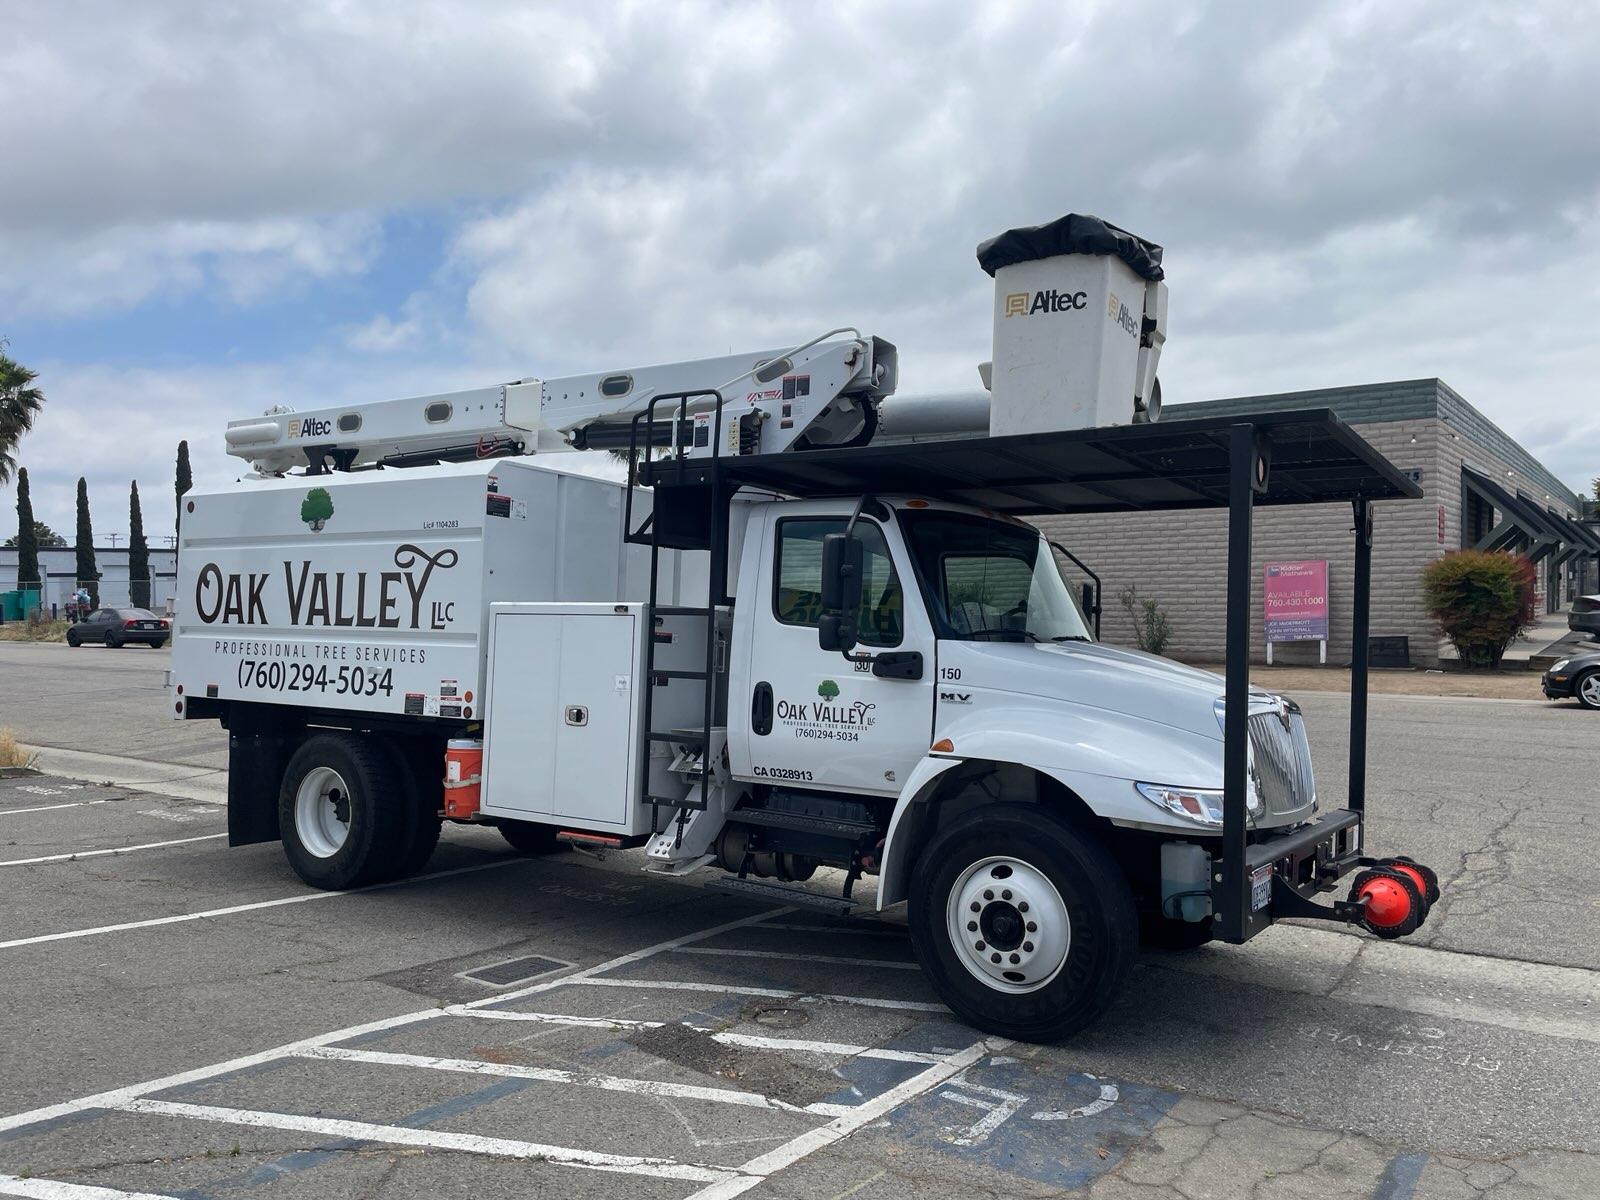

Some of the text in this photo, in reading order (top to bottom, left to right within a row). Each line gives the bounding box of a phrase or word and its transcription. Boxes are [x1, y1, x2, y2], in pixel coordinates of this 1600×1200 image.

[1029, 289, 1087, 315] Altec
[1117, 304, 1138, 339] Altec
[301, 417, 331, 437] Altec
[196, 544, 459, 629] OAK VALLEY LLC
[1267, 590, 1311, 599] AVAILABLE
[1268, 597, 1324, 607] 760.430.1000
[215, 641, 426, 663] PROFESSIONAL TREE SERVICES
[238, 658, 394, 697] (760)294-5034
[941, 667, 961, 680] 150
[941, 693, 972, 701] MV
[777, 700, 808, 720] OAK
[813, 702, 876, 725] VALLEY
[783, 720, 822, 728] PROFESSIONAL
[795, 728, 859, 742] (760)294-5034
[753, 766, 813, 782] CA 0328913
